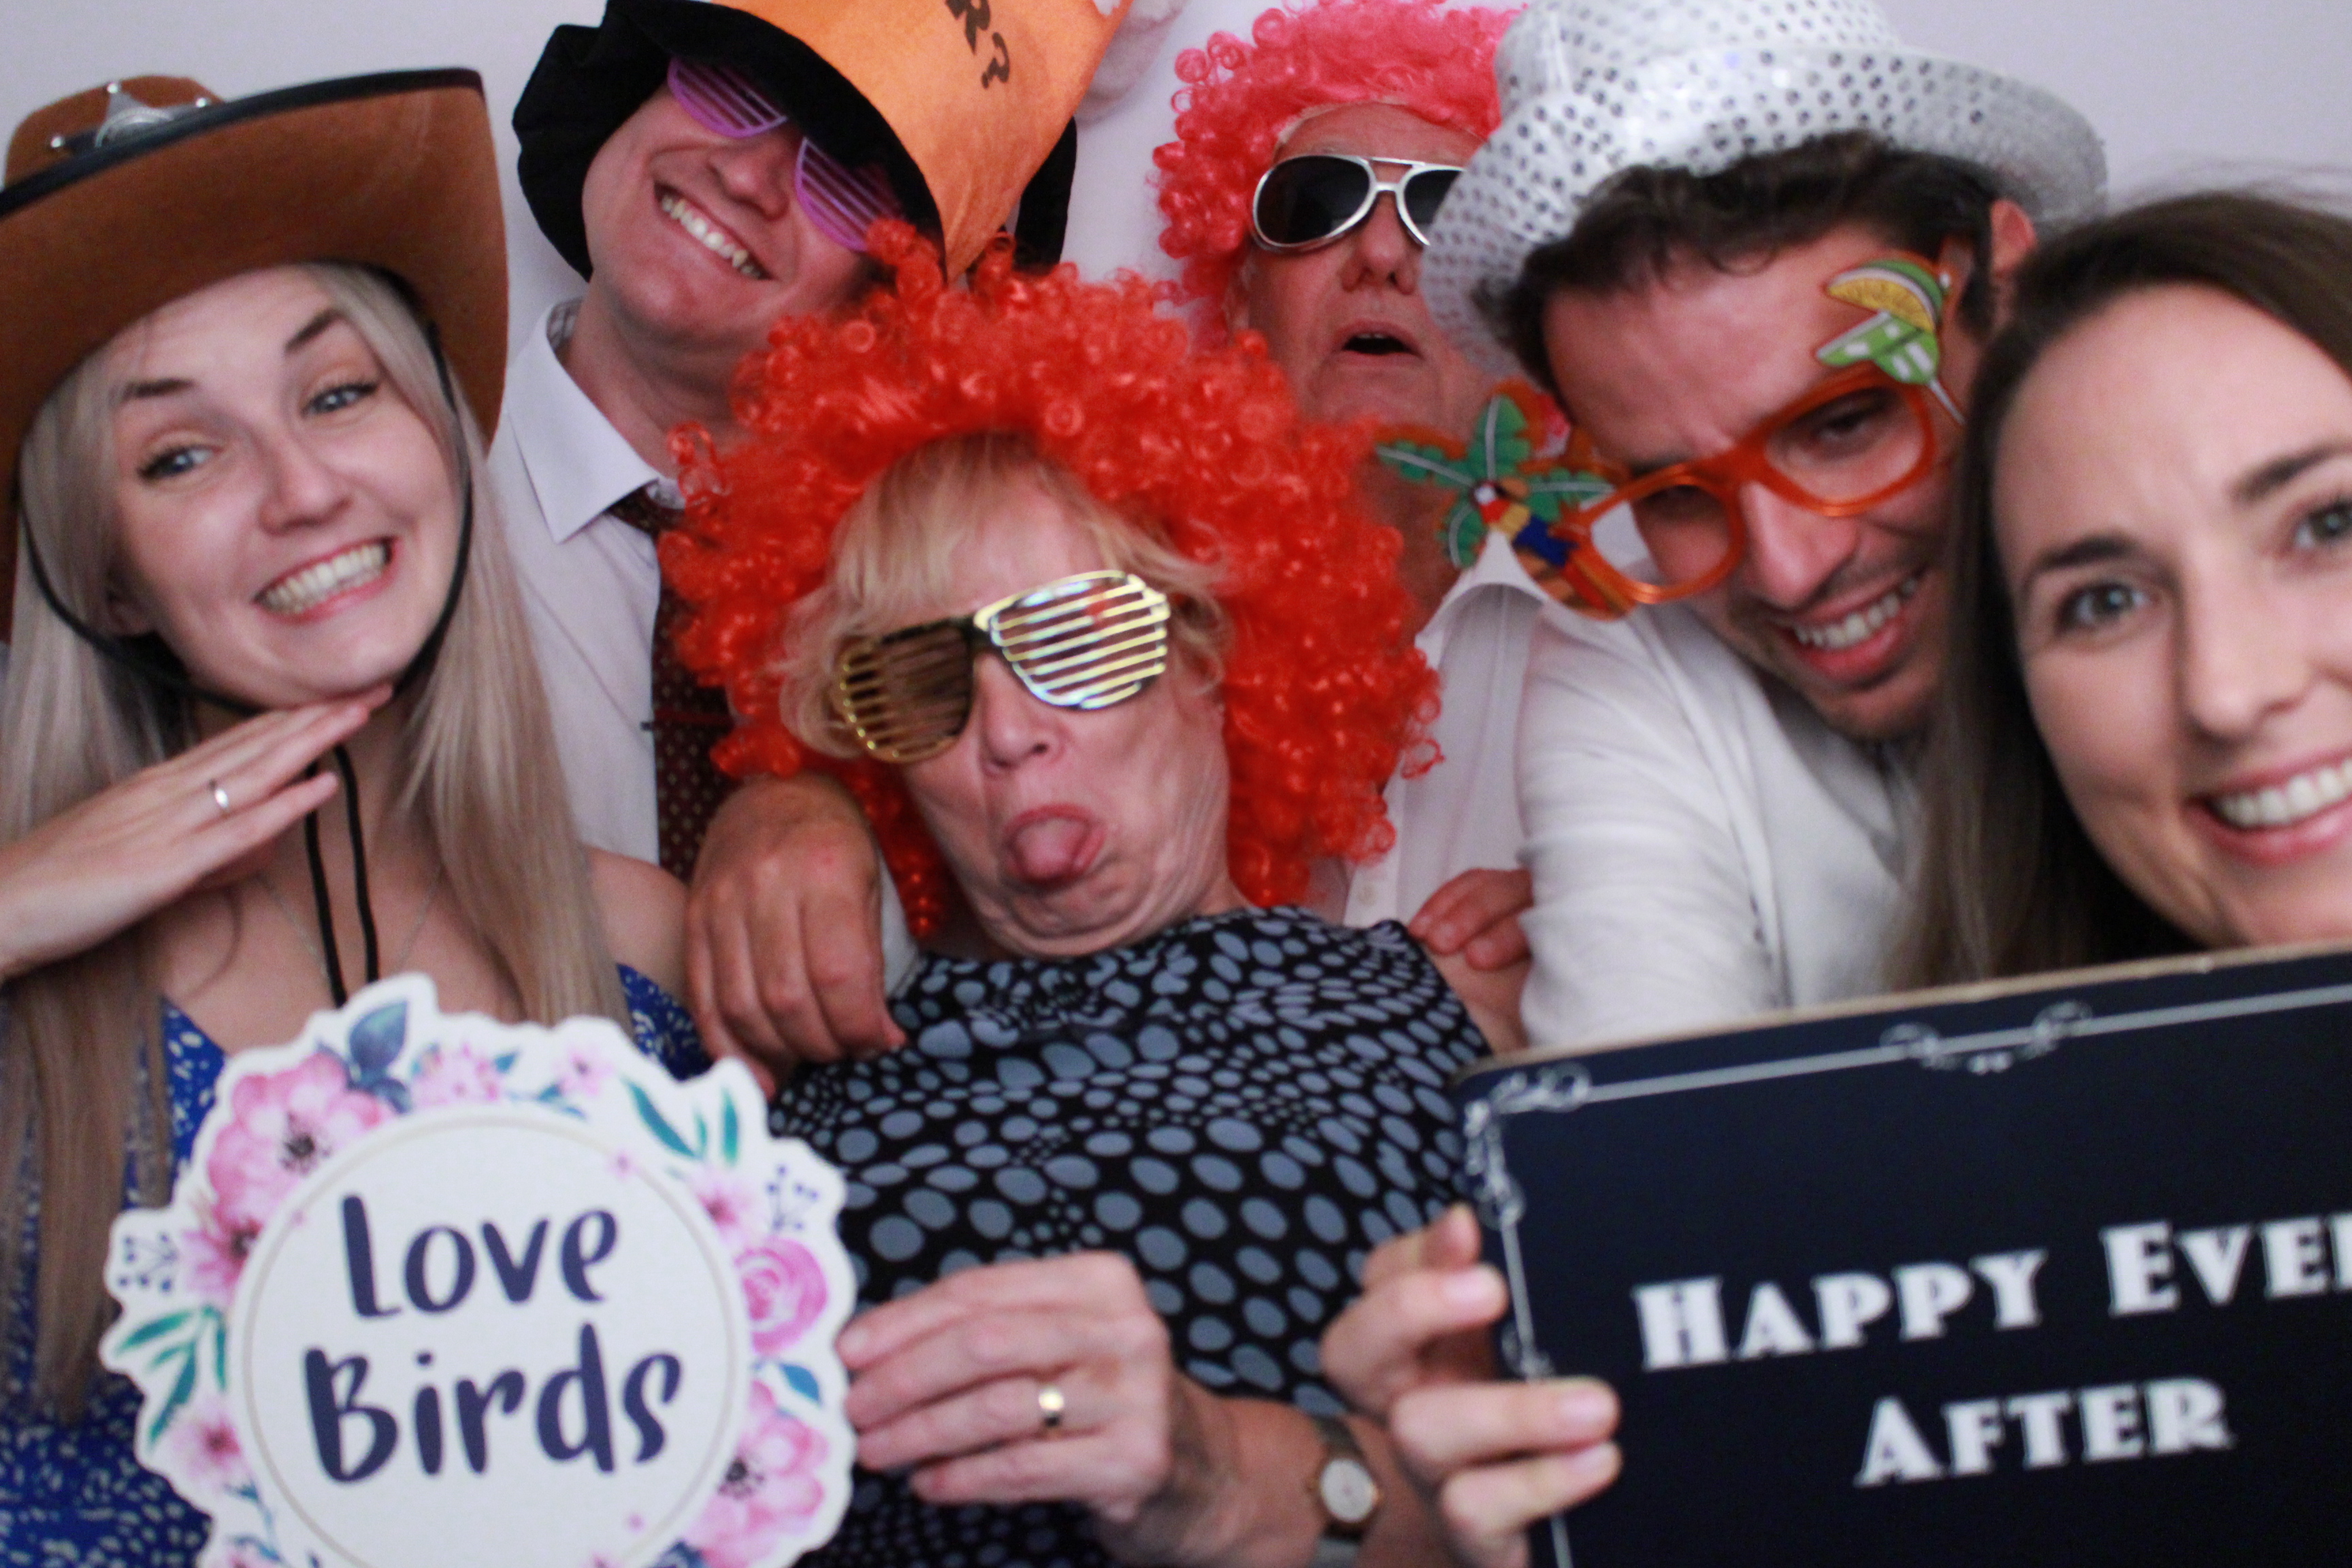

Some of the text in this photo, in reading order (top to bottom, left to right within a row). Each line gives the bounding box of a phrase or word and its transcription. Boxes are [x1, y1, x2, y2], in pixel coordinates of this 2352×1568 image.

[342, 1194, 618, 1318] Love
[1633, 1212, 2352, 1371] HAPPY EVE
[304, 1322, 682, 1484] Birds
[1857, 1377, 2232, 1486] AFTER
